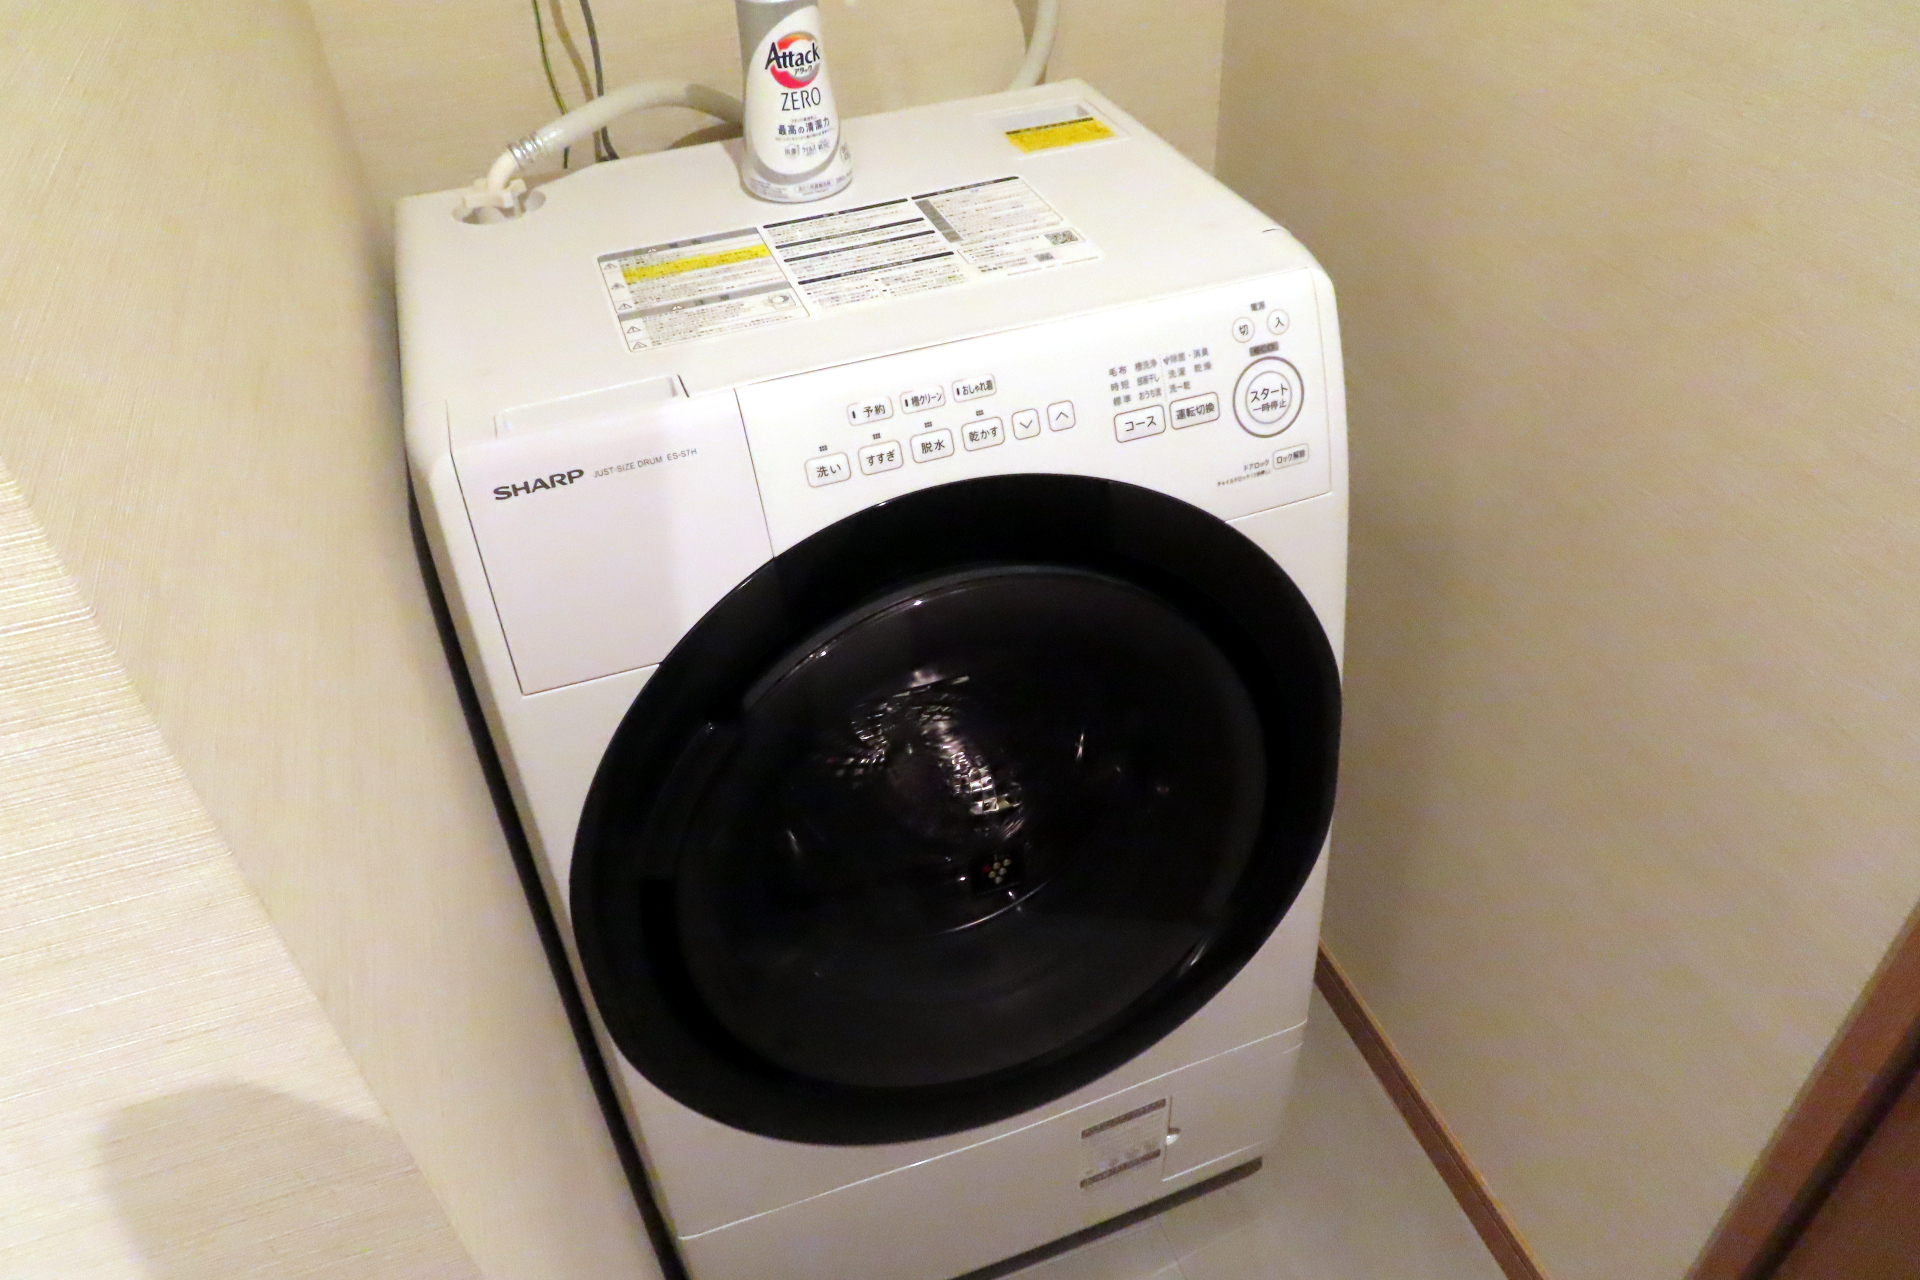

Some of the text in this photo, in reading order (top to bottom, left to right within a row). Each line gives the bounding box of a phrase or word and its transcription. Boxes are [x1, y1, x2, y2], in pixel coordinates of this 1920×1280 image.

[765, 42, 821, 70] Attack
[794, 64, 813, 75] アタック
[781, 86, 822, 112] ZERO
[778, 116, 830, 136] 最高の清潔力
[1239, 324, 1249, 336] 切
[1275, 316, 1284, 328] 入
[1109, 358, 1158, 377] 毛布 槽洗浄
[1168, 361, 1212, 379] 洗濯 乾燥
[962, 380, 994, 396] おしゃれ着
[1110, 373, 1160, 392] 時短 部屋干し
[911, 392, 943, 407] 槽クリーン
[1113, 394, 1132, 407] 標準
[1250, 383, 1288, 404] スタート
[863, 404, 886, 418] 予約
[1176, 402, 1215, 422] 運転切換
[1252, 400, 1287, 413] 一時停止
[1124, 415, 1157, 433] コース
[968, 426, 998, 442] 乾かす
[921, 438, 946, 454] 脱水
[866, 450, 896, 466] すすぎ
[1276, 450, 1306, 464] ロック解除
[816, 464, 842, 478] 洗い
[1244, 459, 1270, 472] ドアロック
[493, 448, 698, 500] SHARP JUST-SIZE DRUM ES-S7H
